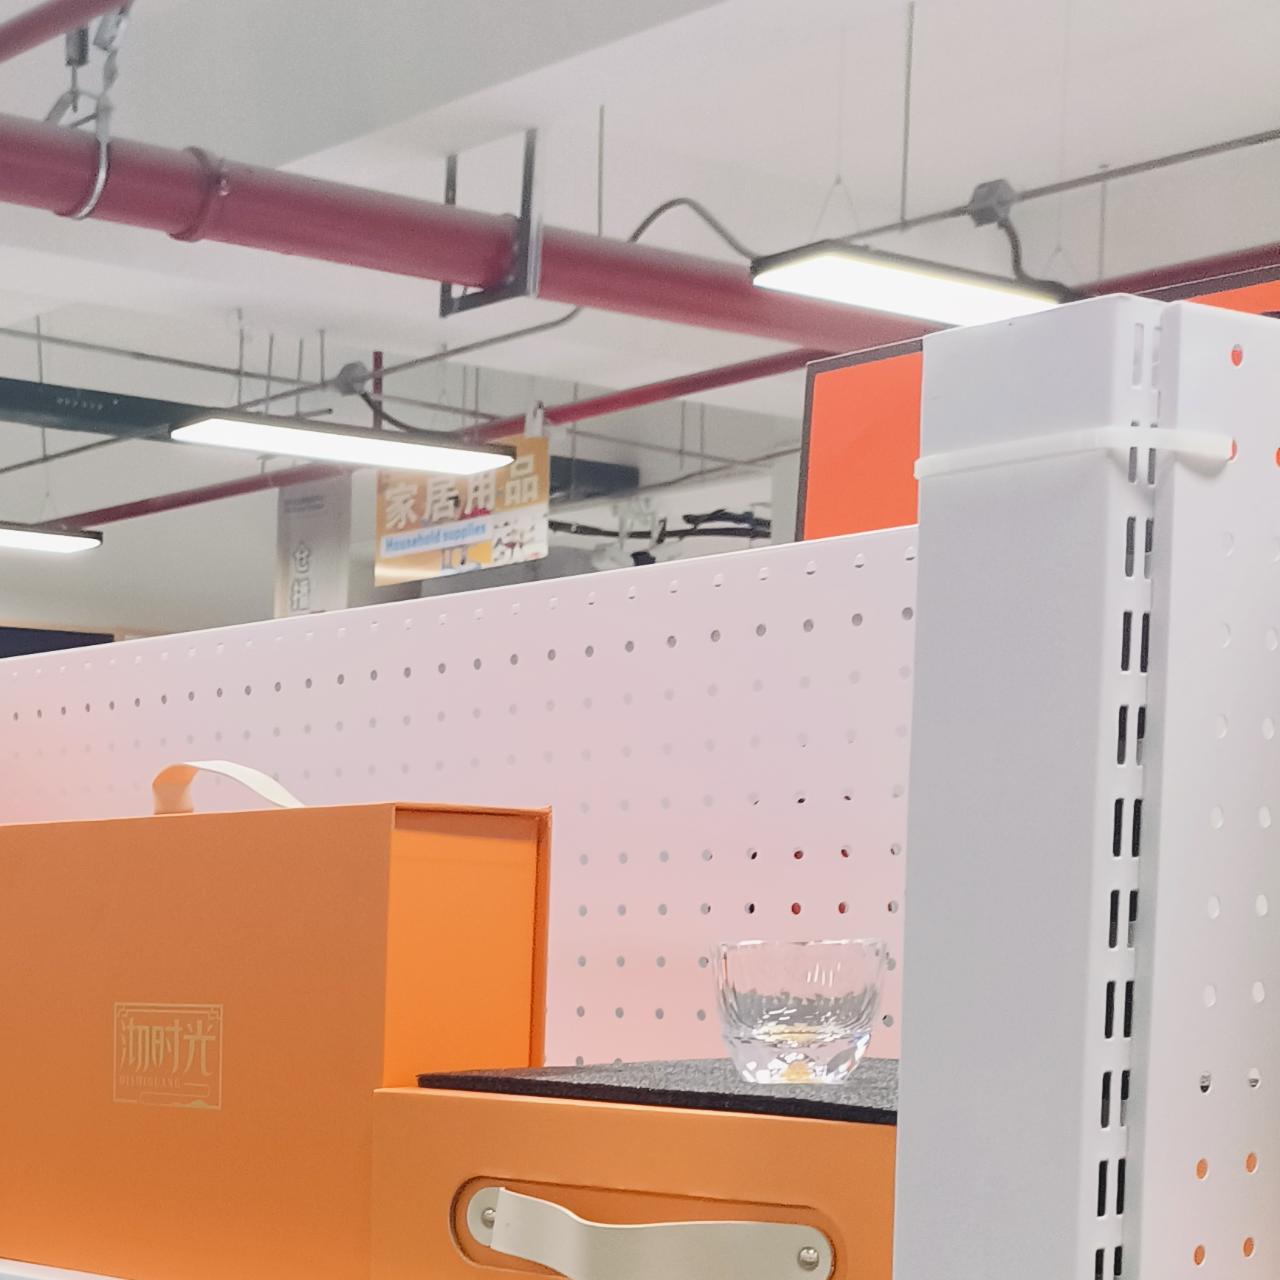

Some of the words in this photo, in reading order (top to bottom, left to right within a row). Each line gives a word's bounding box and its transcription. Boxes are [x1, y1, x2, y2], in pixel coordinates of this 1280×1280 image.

[385, 454, 539, 530] 家居用品
[384, 529, 441, 551] Household
[442, 521, 487, 541] supplies
